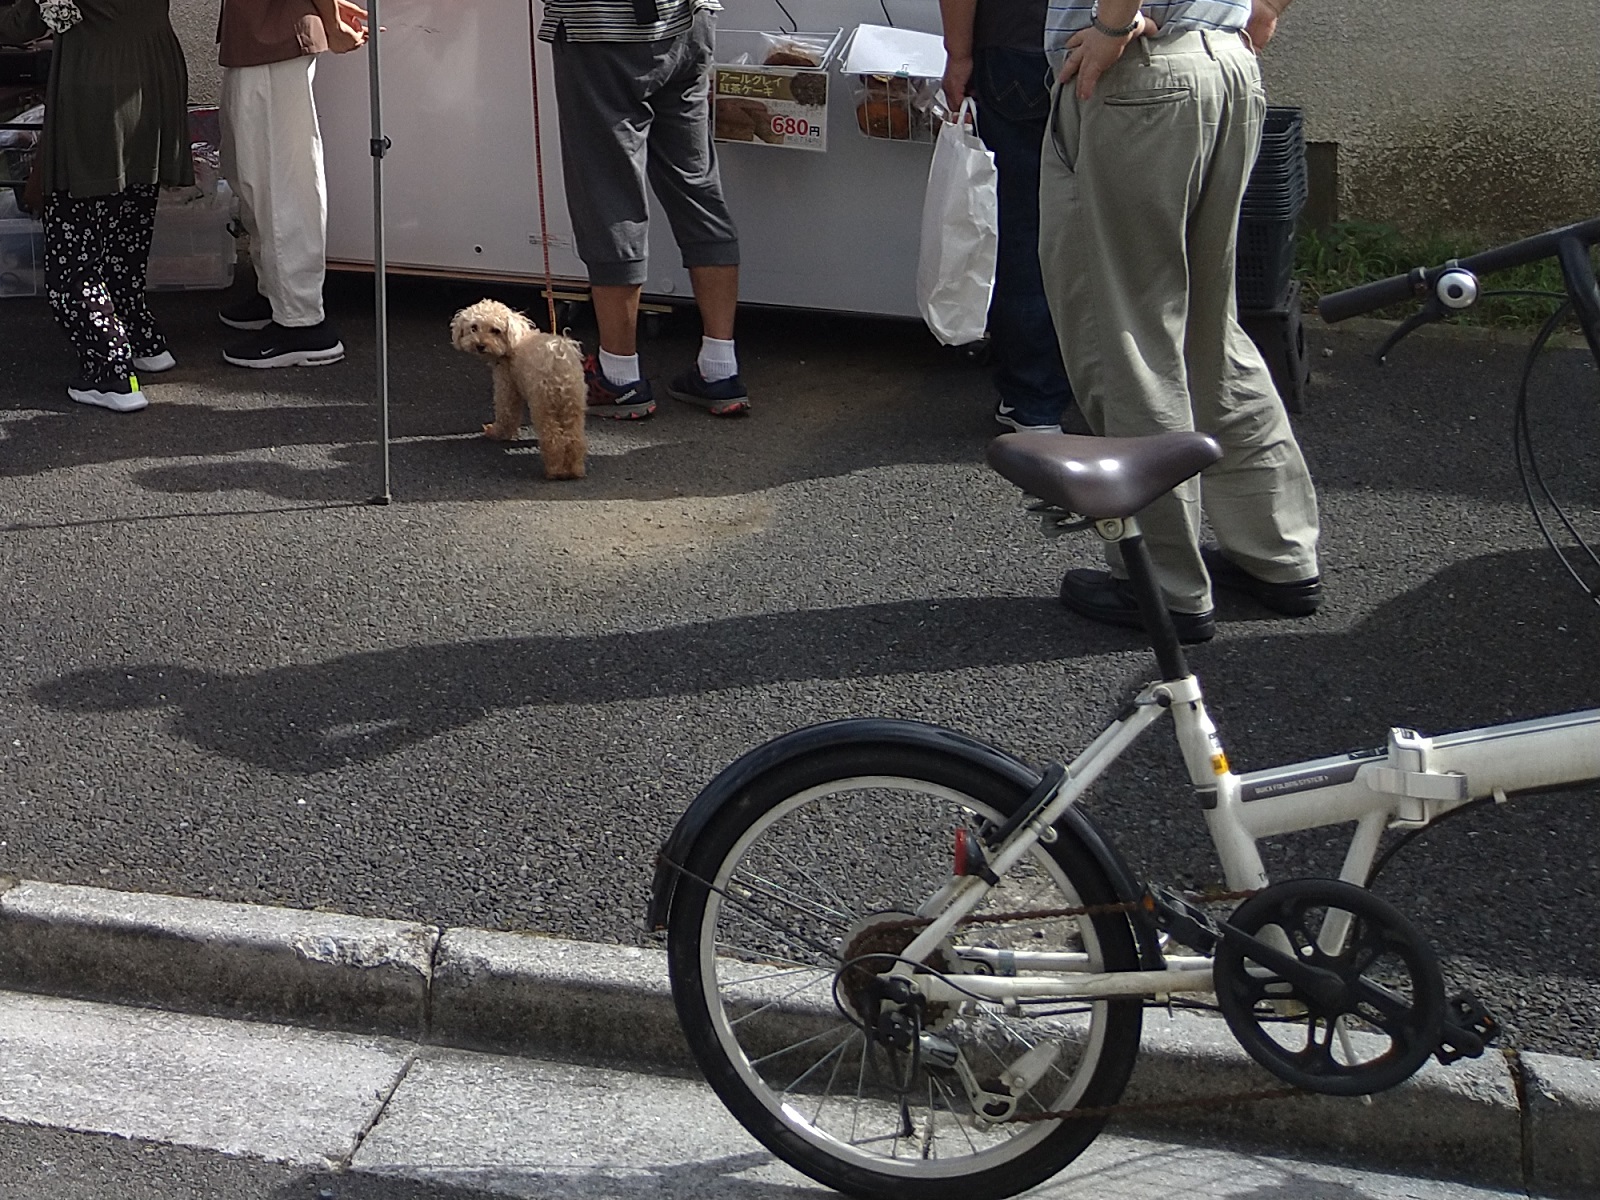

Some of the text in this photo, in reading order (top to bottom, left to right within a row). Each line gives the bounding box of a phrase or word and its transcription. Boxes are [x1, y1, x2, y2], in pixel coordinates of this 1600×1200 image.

[720, 72, 783, 87] アールグレイ
[720, 83, 774, 97] 紅茶ケーキ
[772, 116, 820, 137] 680円
